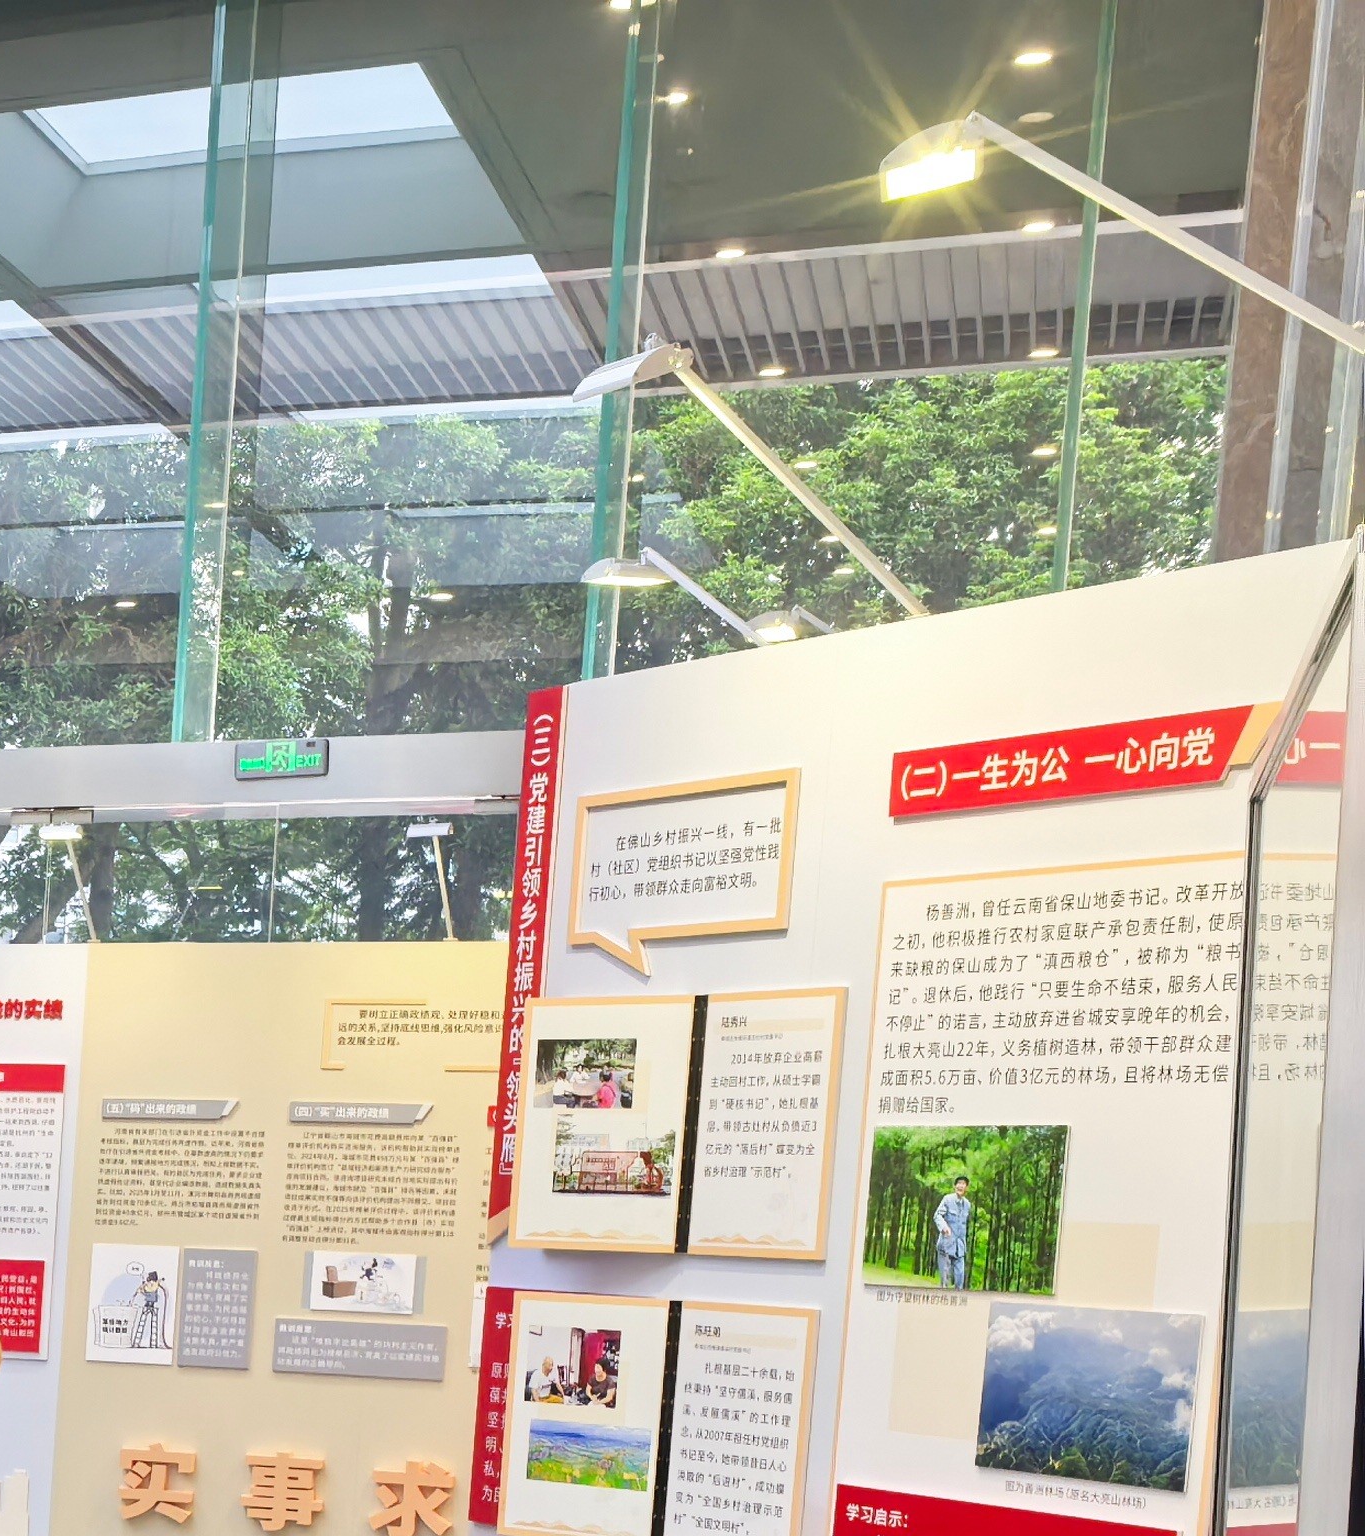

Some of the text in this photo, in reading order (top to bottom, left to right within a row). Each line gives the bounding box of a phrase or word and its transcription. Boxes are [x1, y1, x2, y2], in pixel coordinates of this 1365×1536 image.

[296, 753, 322, 767] EXIT
[900, 727, 1215, 799] （二）一生为公 一心向党
[616, 817, 782, 851] 在佛山乡村振兴一线，有一批
[926, 881, 1244, 921] 杨善洲，曾任云南省保山地委书记。改革开放
[892, 912, 1243, 951] 之初，他积极推行农村家庭联产承包责任制，使原
[890, 942, 1241, 977] 来缺粮的保山成为了“滇西粮仓”，被称为“粮书
[888, 973, 1238, 1005] 记”。退休后，他践行“只要生命不结束，服务人民
[359, 1009, 505, 1020] 要树立正确政绩观，处理好稳和
[885, 1004, 1230, 1033] 不停止”的诺言，主动放弃进省城安享晚年的机会，
[883, 1034, 1232, 1060] 扎根大亮山22年，义务植树造林，带领干部群众建
[880, 1064, 1229, 1087] 成面积5.6万亩、价值3亿元的林场，且将林场无偿
[878, 1096, 955, 1115] 捐赠给国家。
[845, 1504, 909, 1528] 学习启示：
